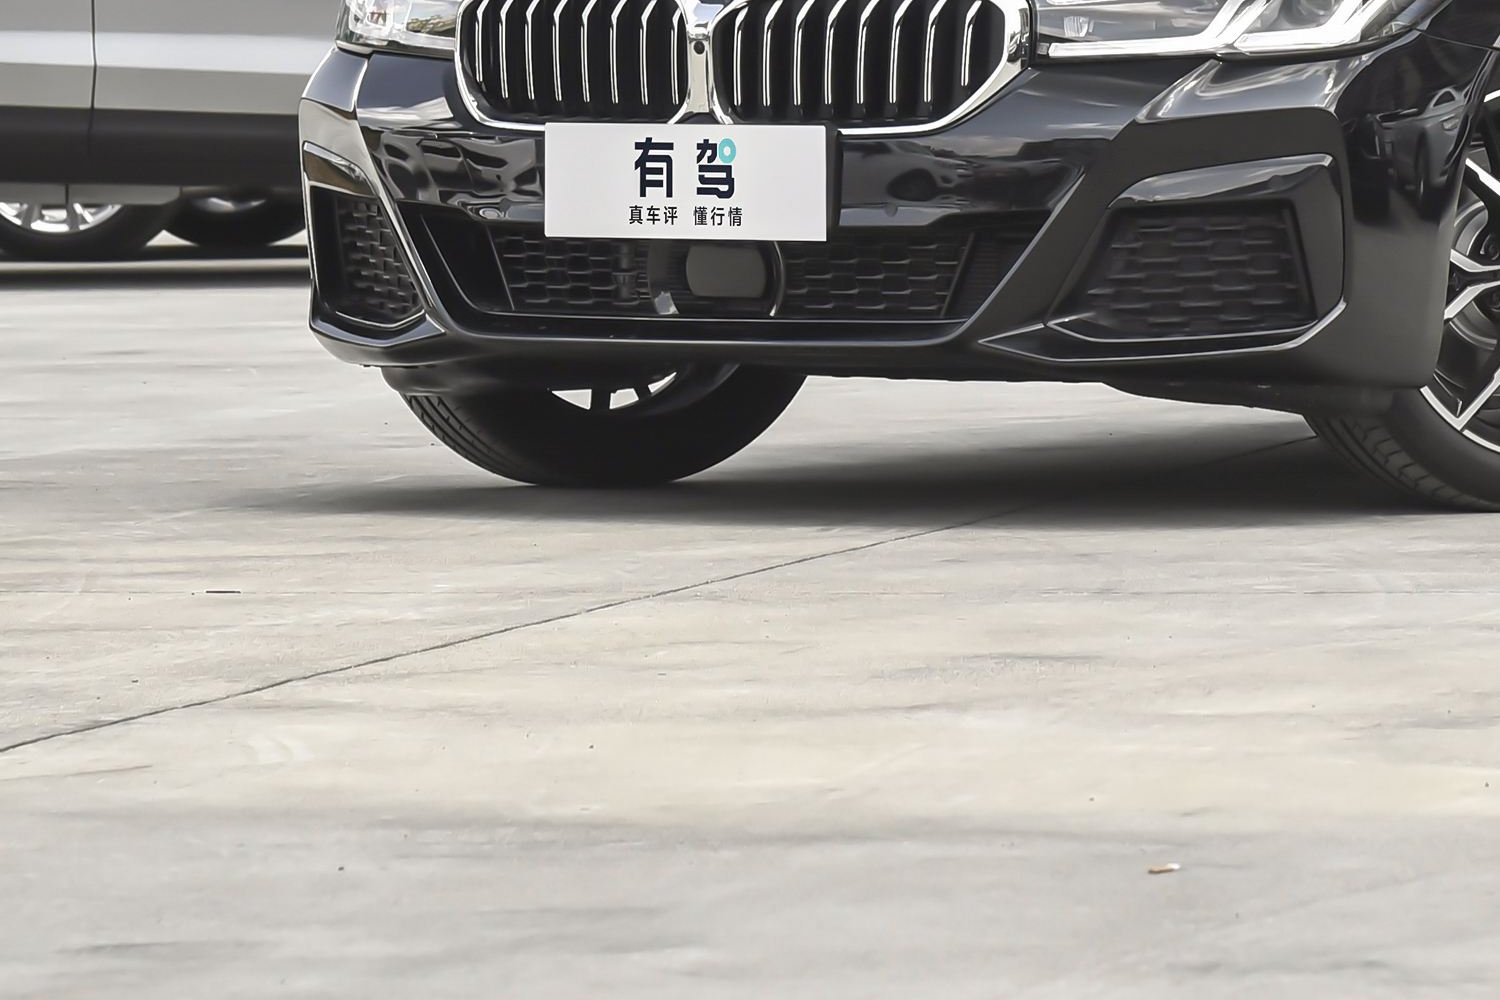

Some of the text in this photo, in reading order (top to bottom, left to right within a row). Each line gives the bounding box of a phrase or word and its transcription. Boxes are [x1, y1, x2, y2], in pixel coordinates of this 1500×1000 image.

[635, 137, 736, 199] 有驾
[629, 205, 742, 226] 真车评 懂行情
